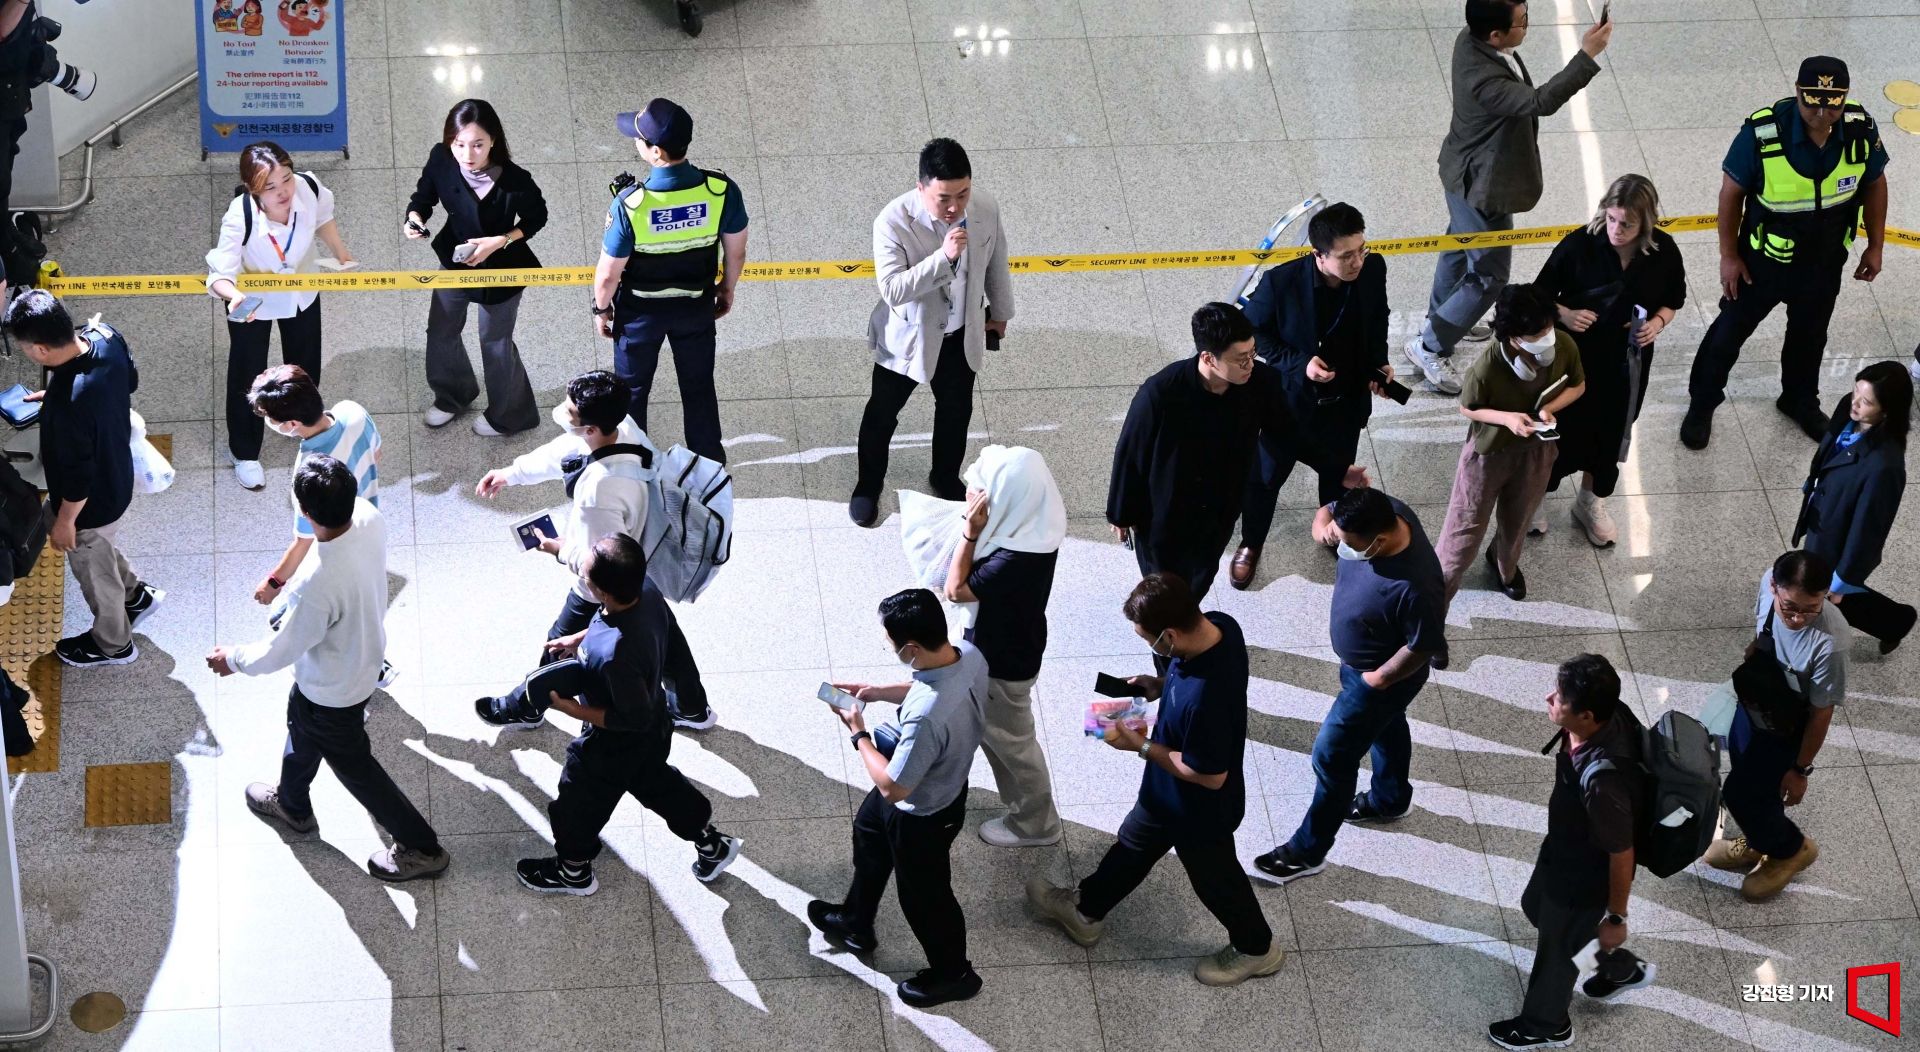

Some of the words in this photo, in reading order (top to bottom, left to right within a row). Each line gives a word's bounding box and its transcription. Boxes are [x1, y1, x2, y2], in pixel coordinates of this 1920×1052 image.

[268, 71, 294, 79] report
[252, 80, 290, 88] reporting
[238, 123, 335, 134] 인천국제공항경찰단
[656, 219, 702, 231] POLICE
[1497, 232, 1534, 241] SECURITY
[1535, 230, 1553, 238] LINE
[788, 267, 821, 275] 보안통제
[244, 280, 282, 288] SECURITY
[285, 279, 303, 287] LINE
[309, 278, 357, 286] 인천국제공항
[363, 277, 396, 285] 보안통제
[459, 276, 497, 284] SECURITY
[500, 275, 517, 283] LINE
[523, 273, 571, 282] 인천국제공항
[68, 282, 86, 290] LINE
